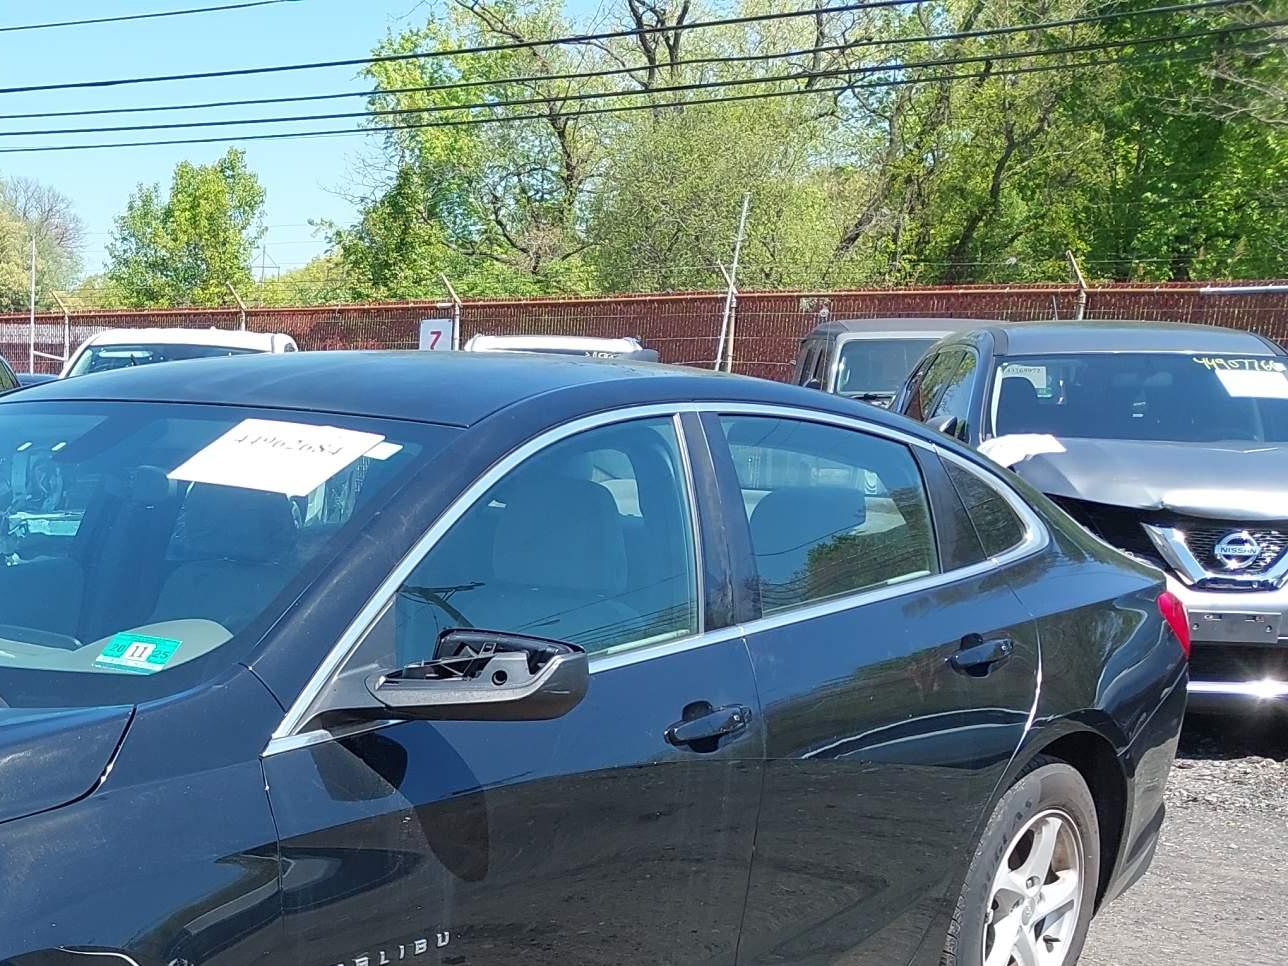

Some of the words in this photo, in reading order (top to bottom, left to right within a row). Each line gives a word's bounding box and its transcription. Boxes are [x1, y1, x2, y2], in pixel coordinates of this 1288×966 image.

[430, 330, 442, 350] 7
[109, 643, 127, 653] 20
[128, 645, 148, 659] 11
[152, 650, 169, 660] 25
